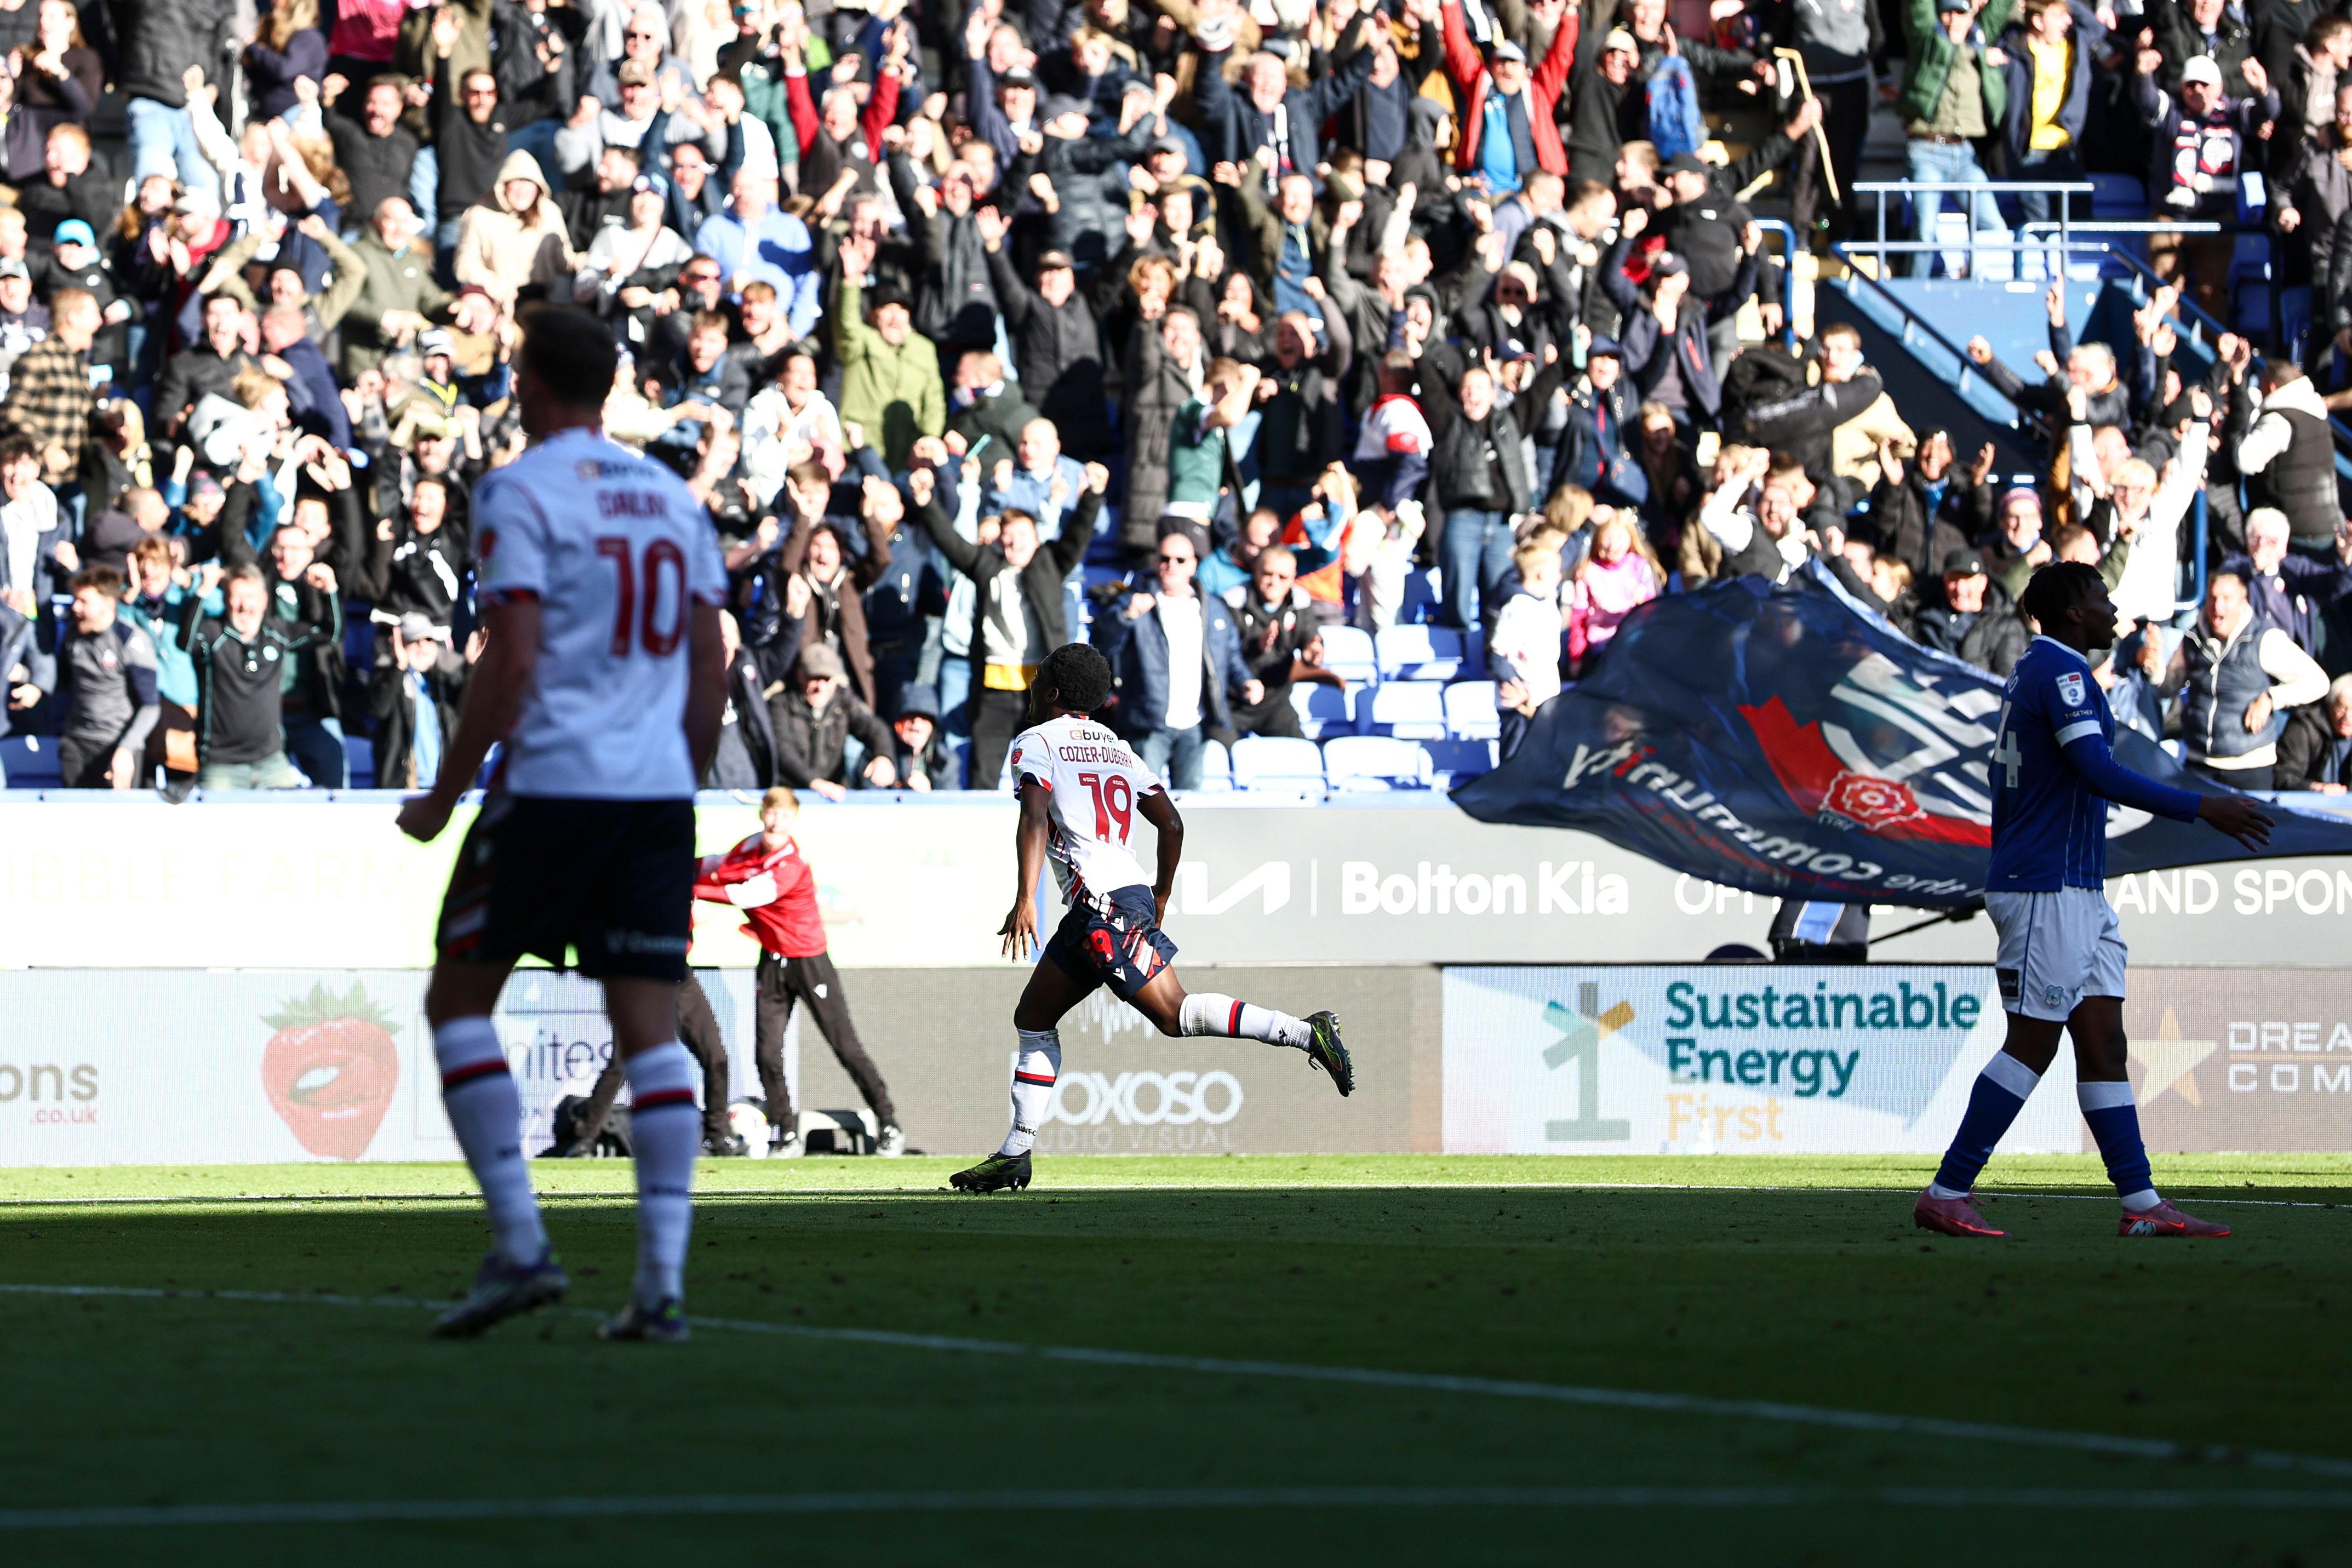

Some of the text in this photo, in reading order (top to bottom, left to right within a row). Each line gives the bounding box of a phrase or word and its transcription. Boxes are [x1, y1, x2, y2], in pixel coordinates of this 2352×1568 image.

[596, 537, 686, 656] 10
[1059, 746, 1133, 769] COZIER-DUBERRY
[1070, 729, 1116, 743] ebuyer
[1078, 773, 1132, 846] 19
[1341, 861, 1527, 915] Bolton
[1538, 861, 1629, 915] Kia
[2111, 869, 2219, 914] AND
[1665, 981, 1981, 1030] Sustainable
[0, 1063, 98, 1101] ons
[1009, 1051, 1244, 1125] OXOSO
[1666, 1038, 1859, 1097] Energy
[2228, 1063, 2352, 1093] COM
[1016, 1123, 1037, 1136] BWFC
[1035, 1126, 1237, 1151] UDIO VISUAL
[1665, 1093, 1783, 1141] First
